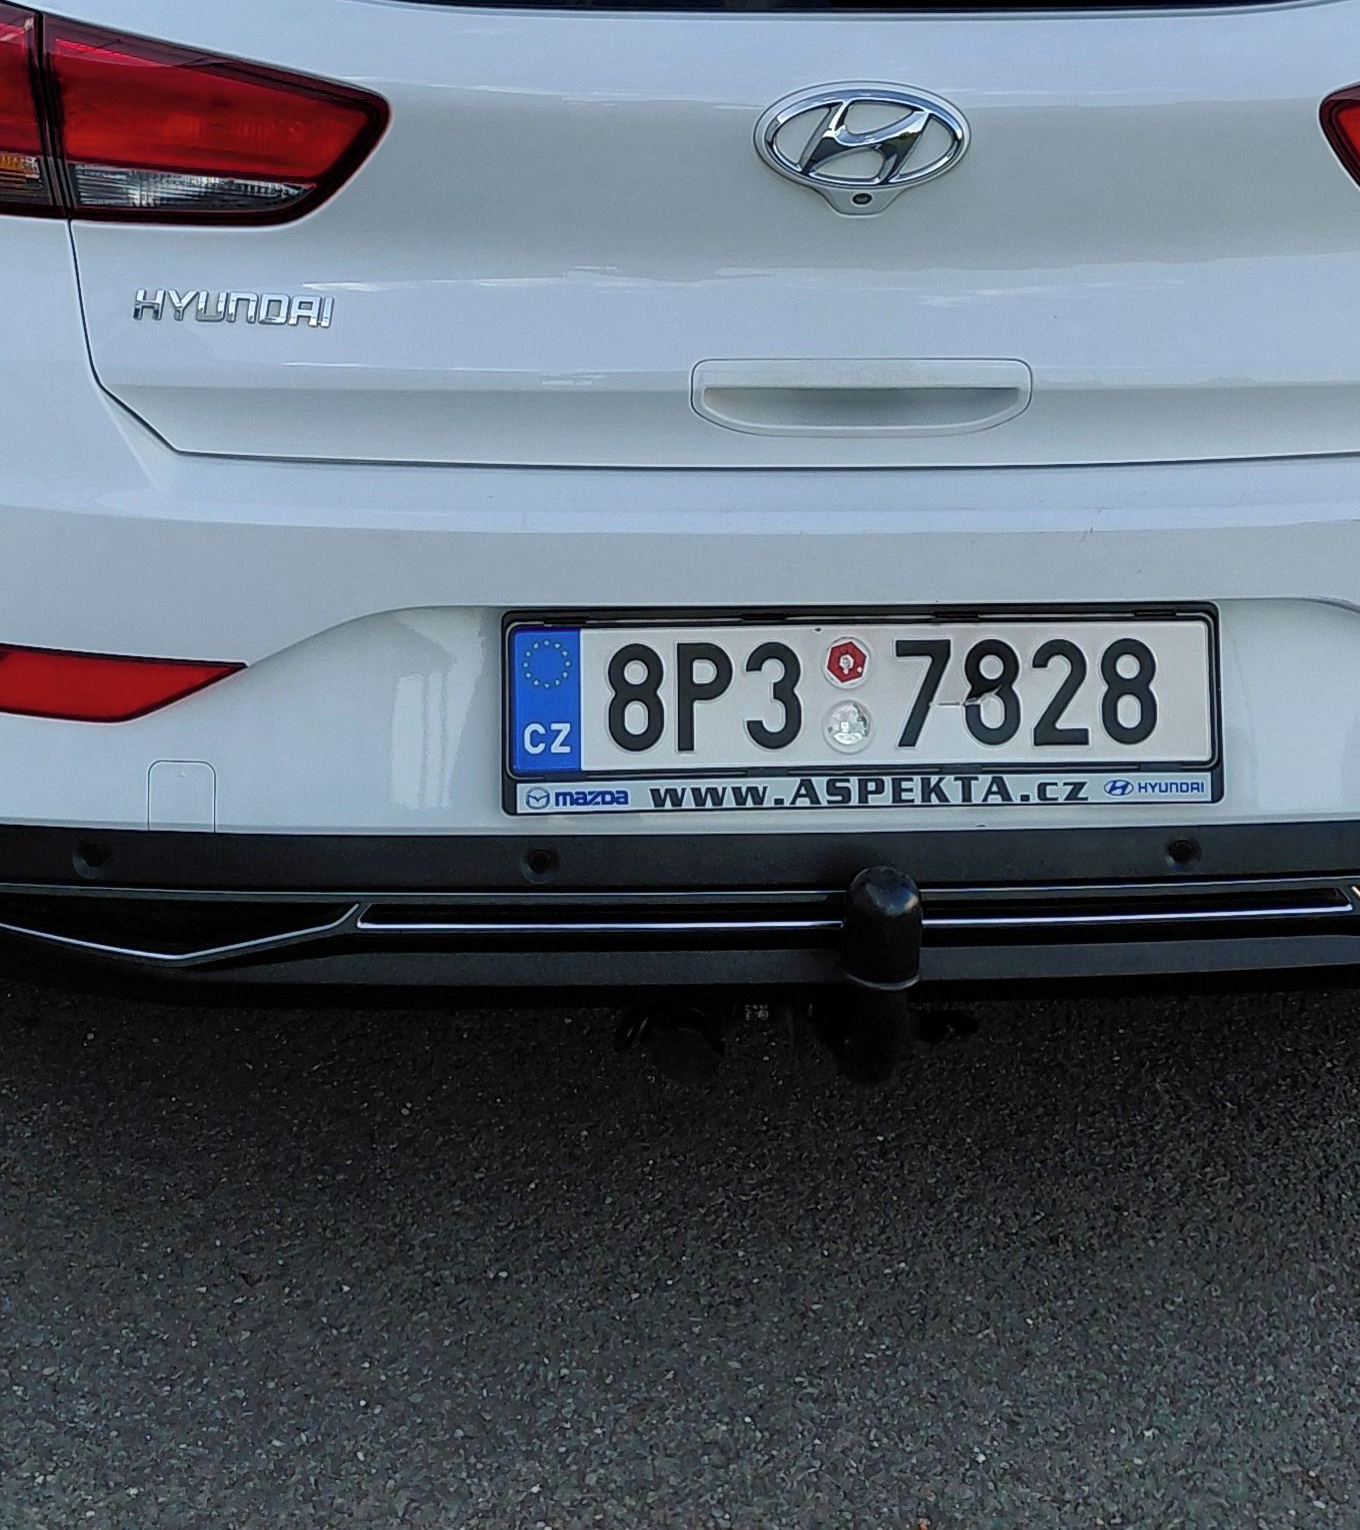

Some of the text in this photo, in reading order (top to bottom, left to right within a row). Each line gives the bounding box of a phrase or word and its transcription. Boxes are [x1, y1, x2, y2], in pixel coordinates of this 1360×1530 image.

[133, 288, 336, 329] HYUNDAI
[607, 637, 1158, 753] 8P3 7828
[523, 722, 572, 755] CZ
[649, 774, 1090, 809] www.ASPEKTA.cz
[1137, 782, 1205, 794] HYUNDAI
